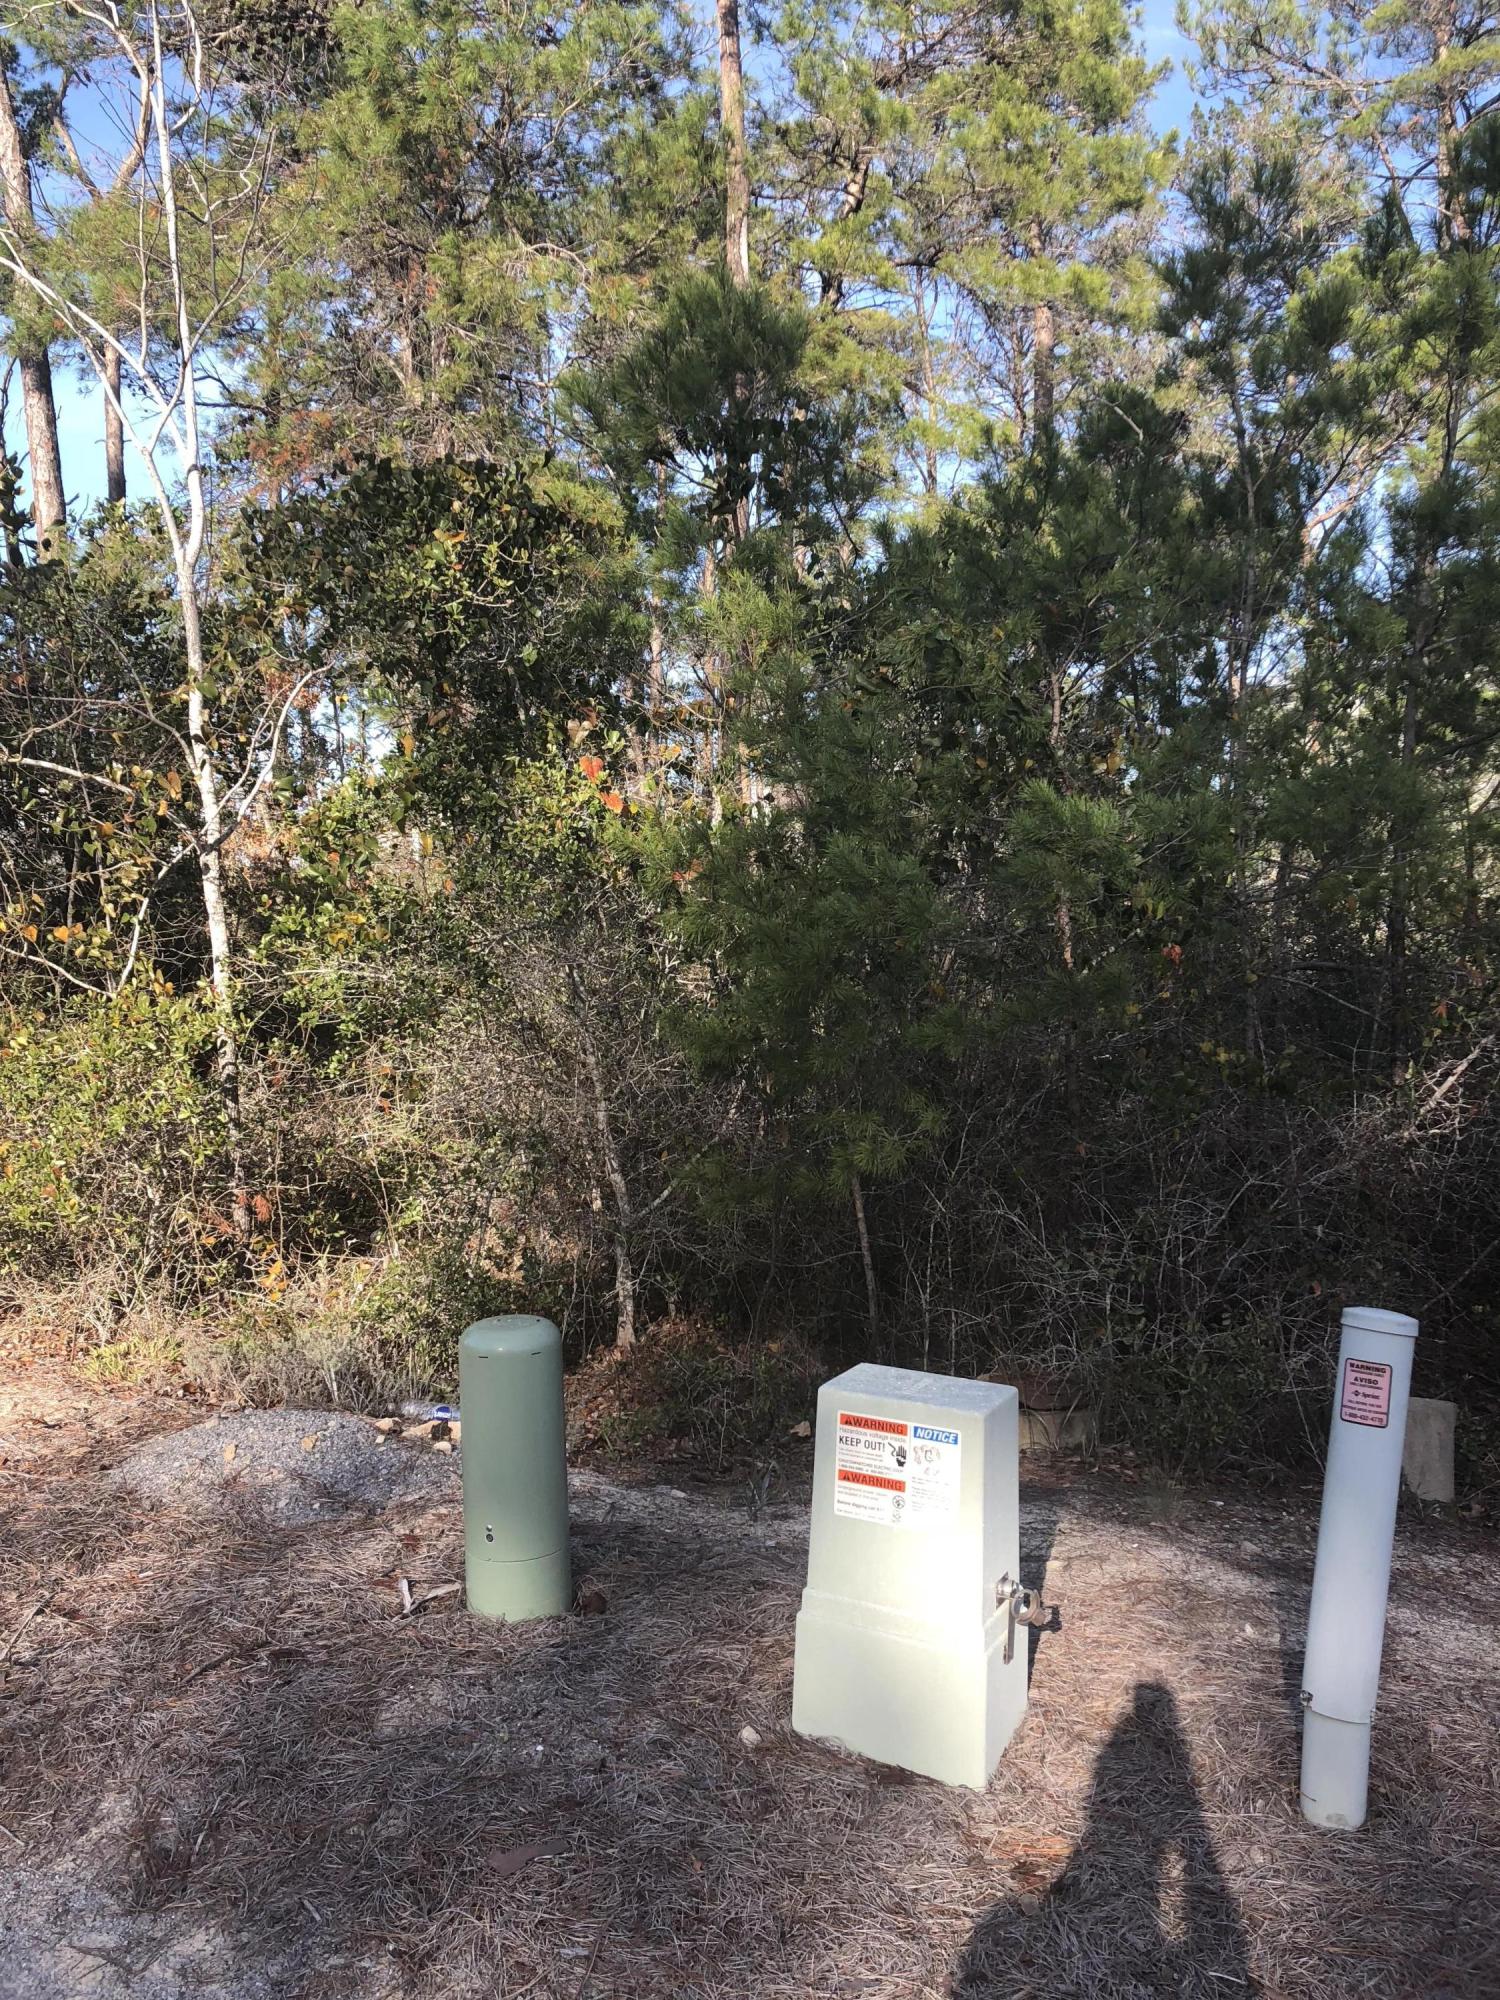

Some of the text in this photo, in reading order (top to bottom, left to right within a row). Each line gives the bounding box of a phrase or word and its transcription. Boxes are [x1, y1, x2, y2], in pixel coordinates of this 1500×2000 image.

[1349, 1362, 1387, 1374] WARNING
[1353, 1376, 1379, 1386] AVISO
[852, 1416, 904, 1435] WARNING
[839, 1435, 862, 1447] KEEP
[864, 1439, 886, 1453] OUT!
[916, 1428, 957, 1444] NOTICE
[851, 1473, 902, 1491] WARNING
